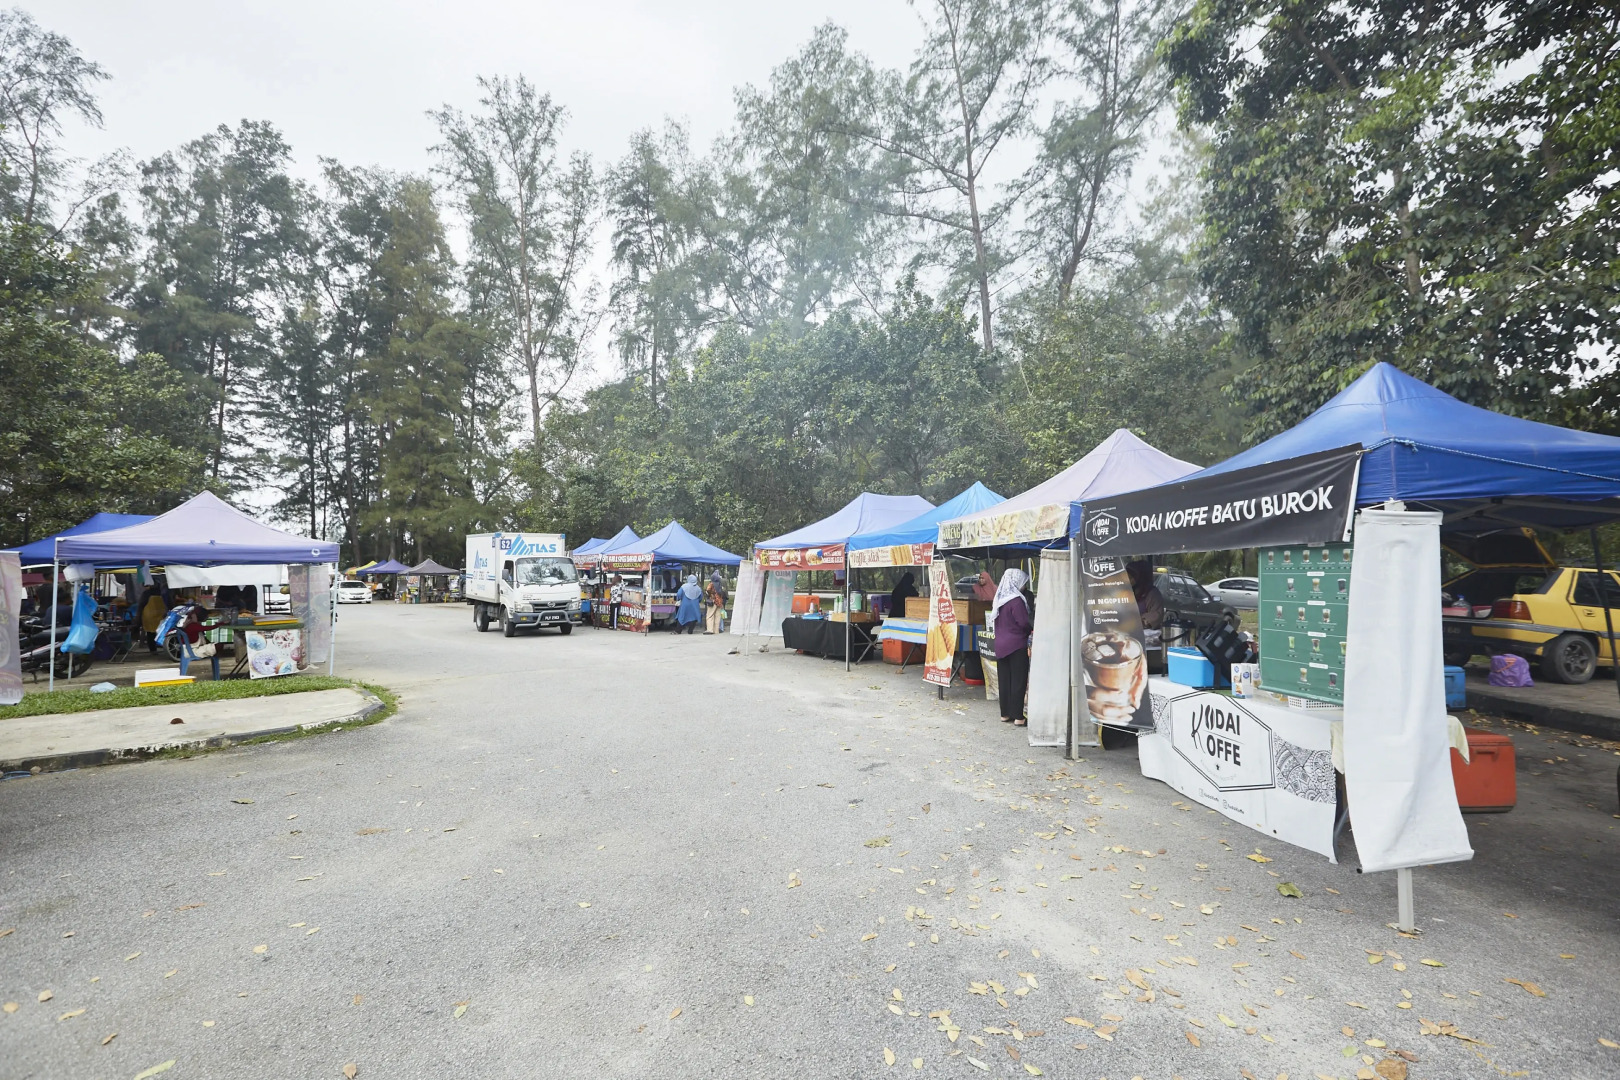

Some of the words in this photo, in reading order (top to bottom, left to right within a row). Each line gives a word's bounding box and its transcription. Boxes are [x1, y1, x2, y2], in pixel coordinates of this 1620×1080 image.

[1126, 512, 1163, 534] KODAI
[1165, 506, 1209, 530] KOFFE
[1212, 499, 1256, 525] BATU
[1261, 486, 1334, 518] BUROK
[501, 540, 511, 549] S2
